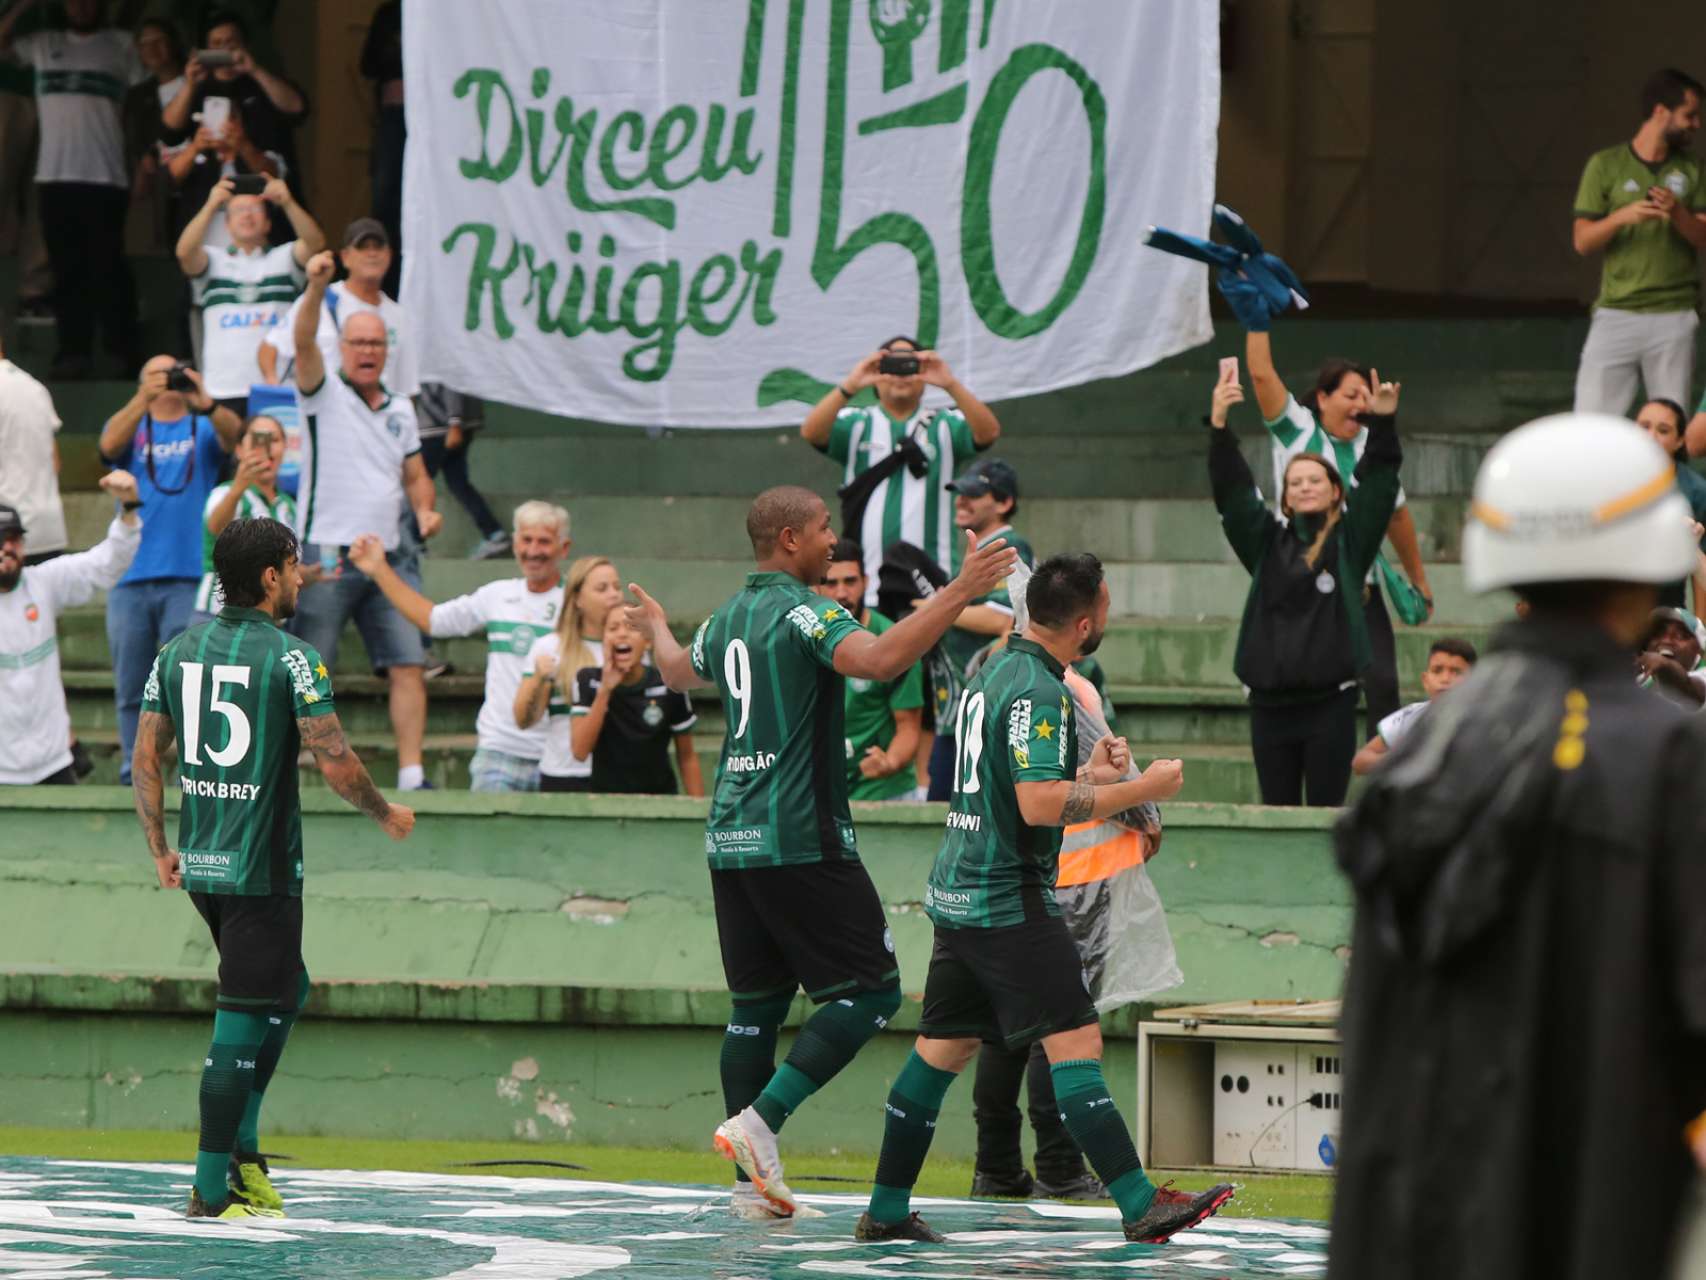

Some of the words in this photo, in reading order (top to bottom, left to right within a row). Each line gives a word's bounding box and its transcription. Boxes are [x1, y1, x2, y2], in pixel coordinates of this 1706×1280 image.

[453, 67, 763, 231] Dirceu
[220, 311, 279, 329] CAIXA
[441, 222, 783, 382] Krüger
[178, 661, 251, 767] 15
[724, 638, 752, 739] 9
[954, 689, 985, 793] 10
[187, 853, 230, 865] BOURBON
[715, 829, 762, 841] BOURBON
